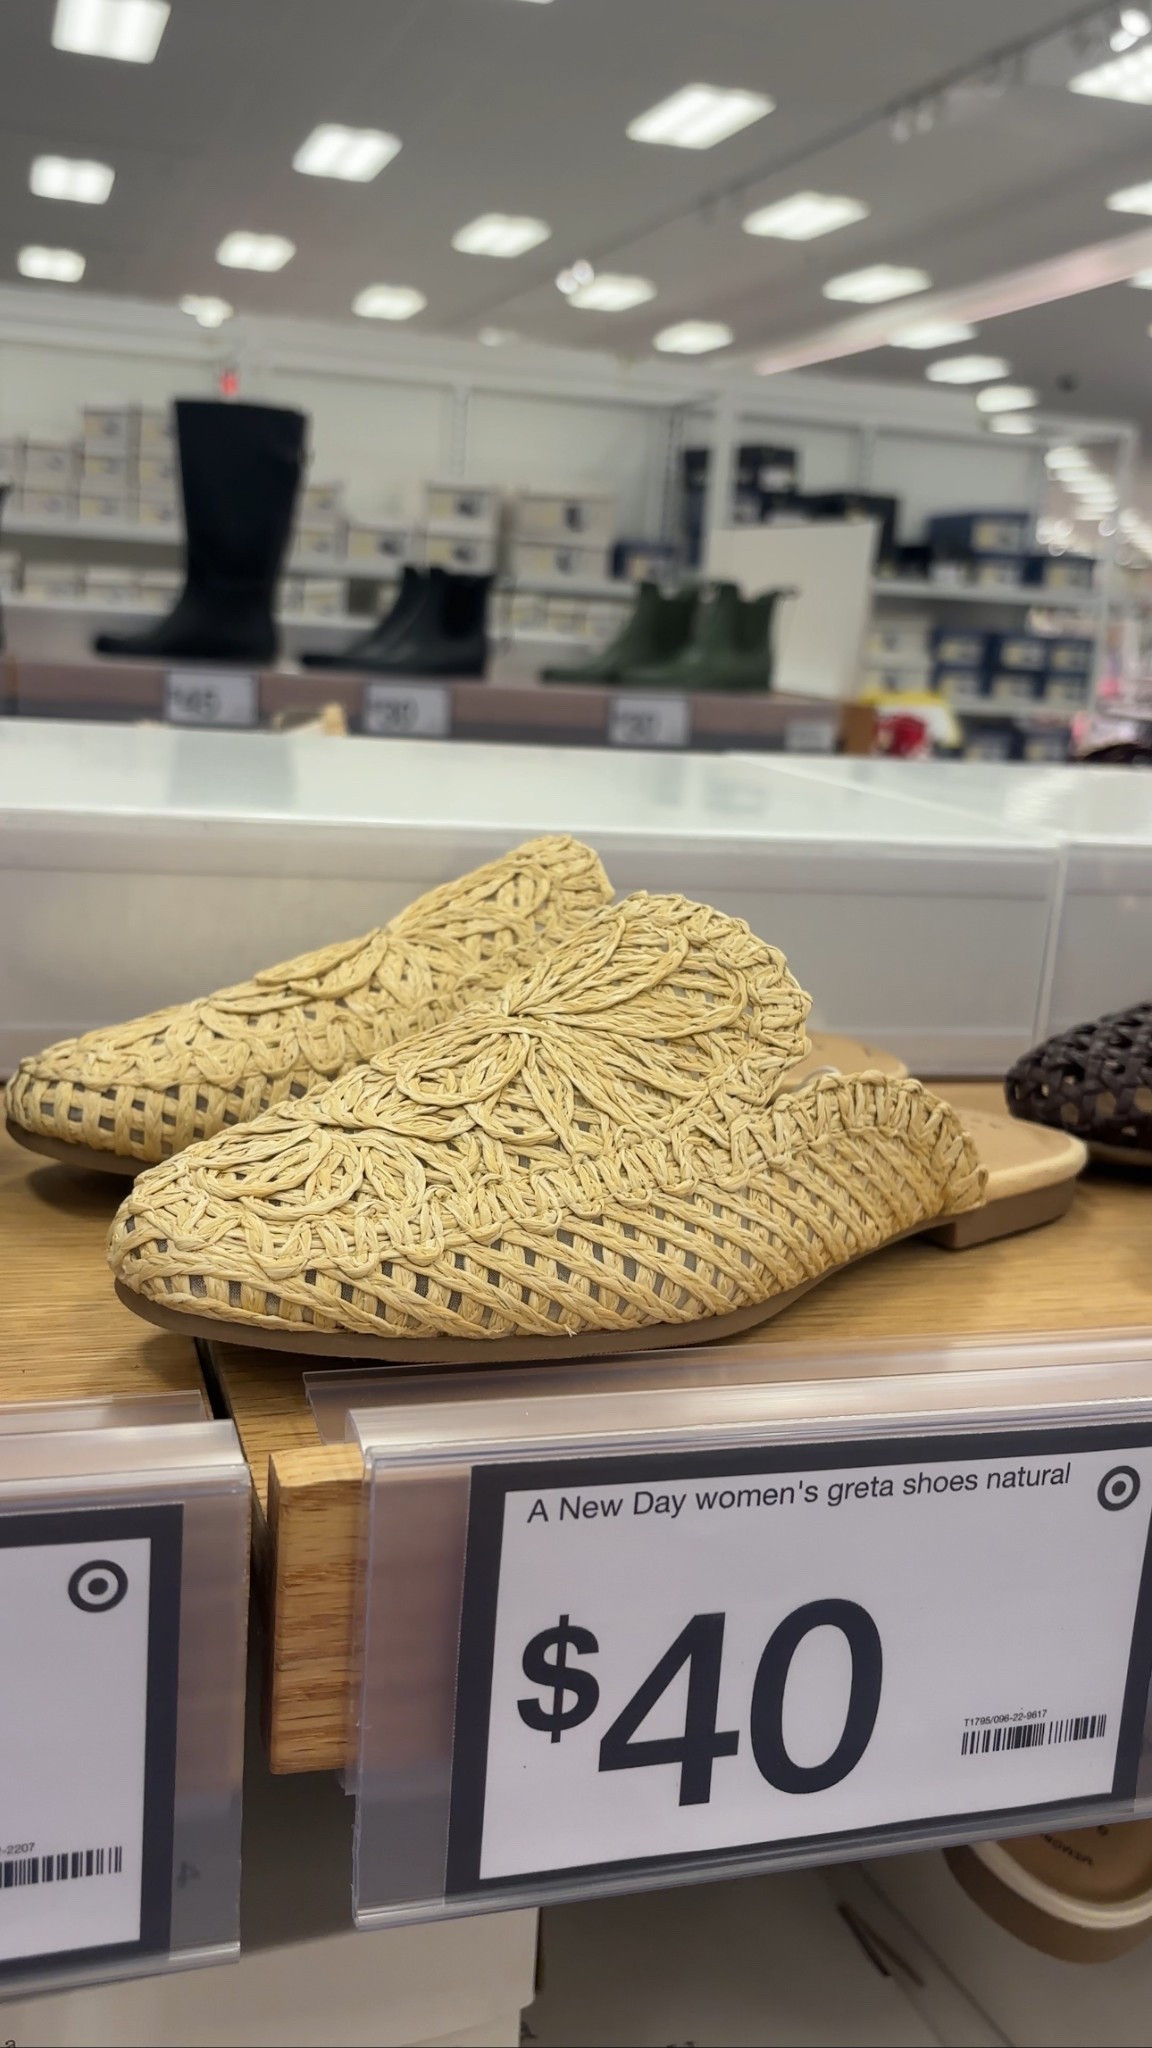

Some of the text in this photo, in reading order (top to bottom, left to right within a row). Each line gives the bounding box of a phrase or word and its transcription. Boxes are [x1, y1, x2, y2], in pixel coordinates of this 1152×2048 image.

[527, 1461, 1072, 1524] A New Day women's greta shoes natural
[516, 1597, 884, 1807] $40
